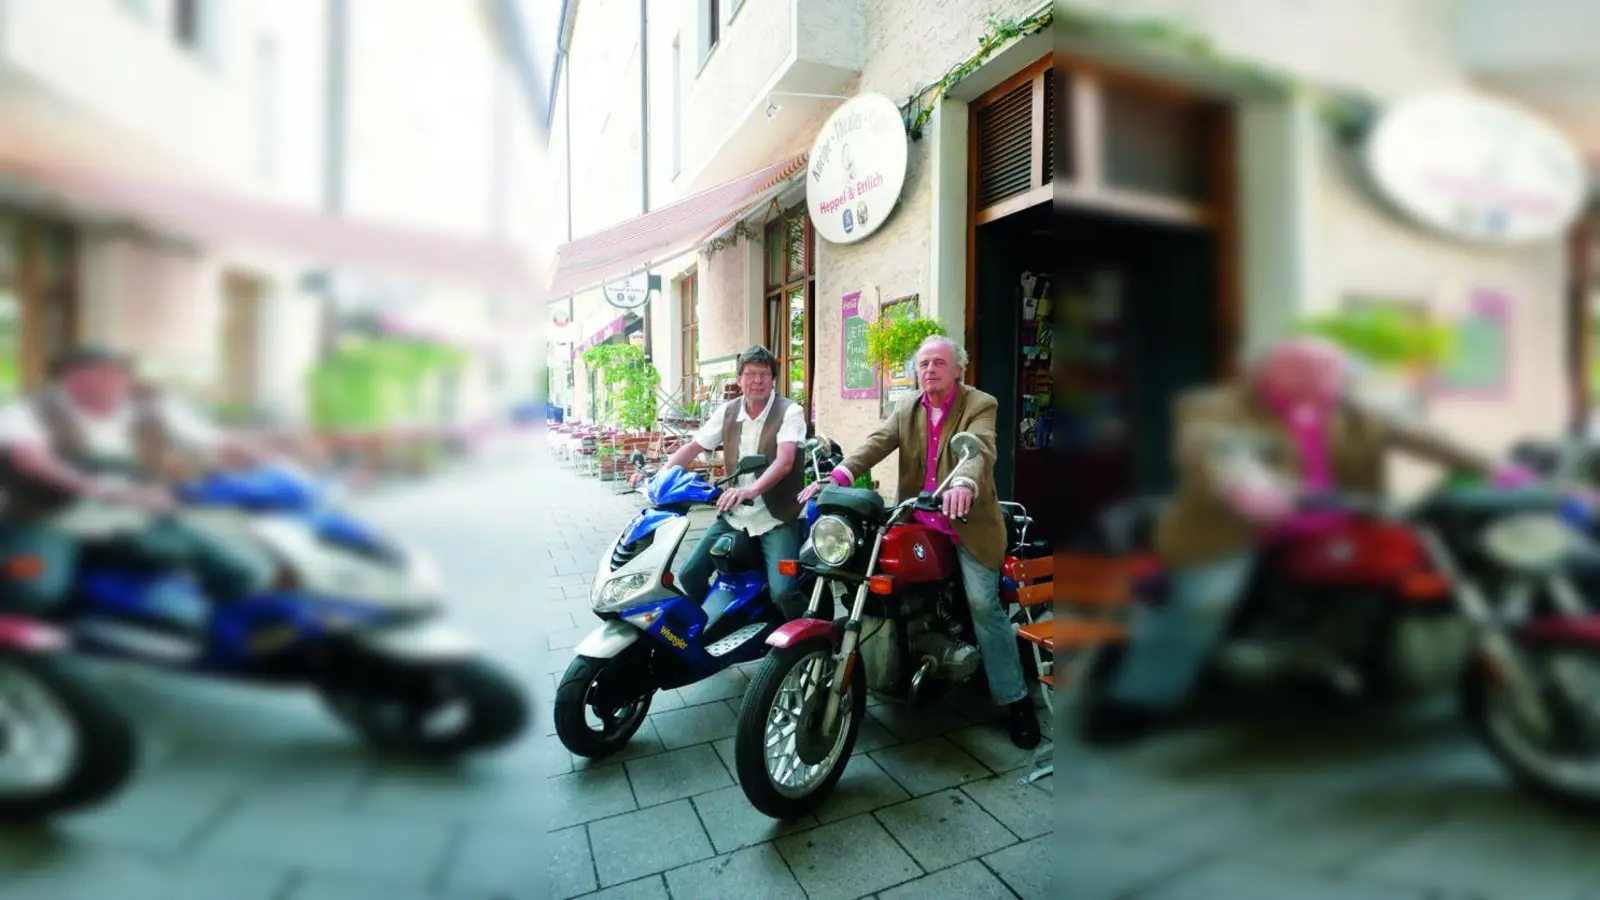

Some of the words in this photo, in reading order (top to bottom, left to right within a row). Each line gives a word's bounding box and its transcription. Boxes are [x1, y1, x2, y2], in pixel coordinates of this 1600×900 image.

[820, 190, 846, 215] Heppel
[857, 170, 883, 196] Ettlich
[660, 625, 687, 650] Wrangler
